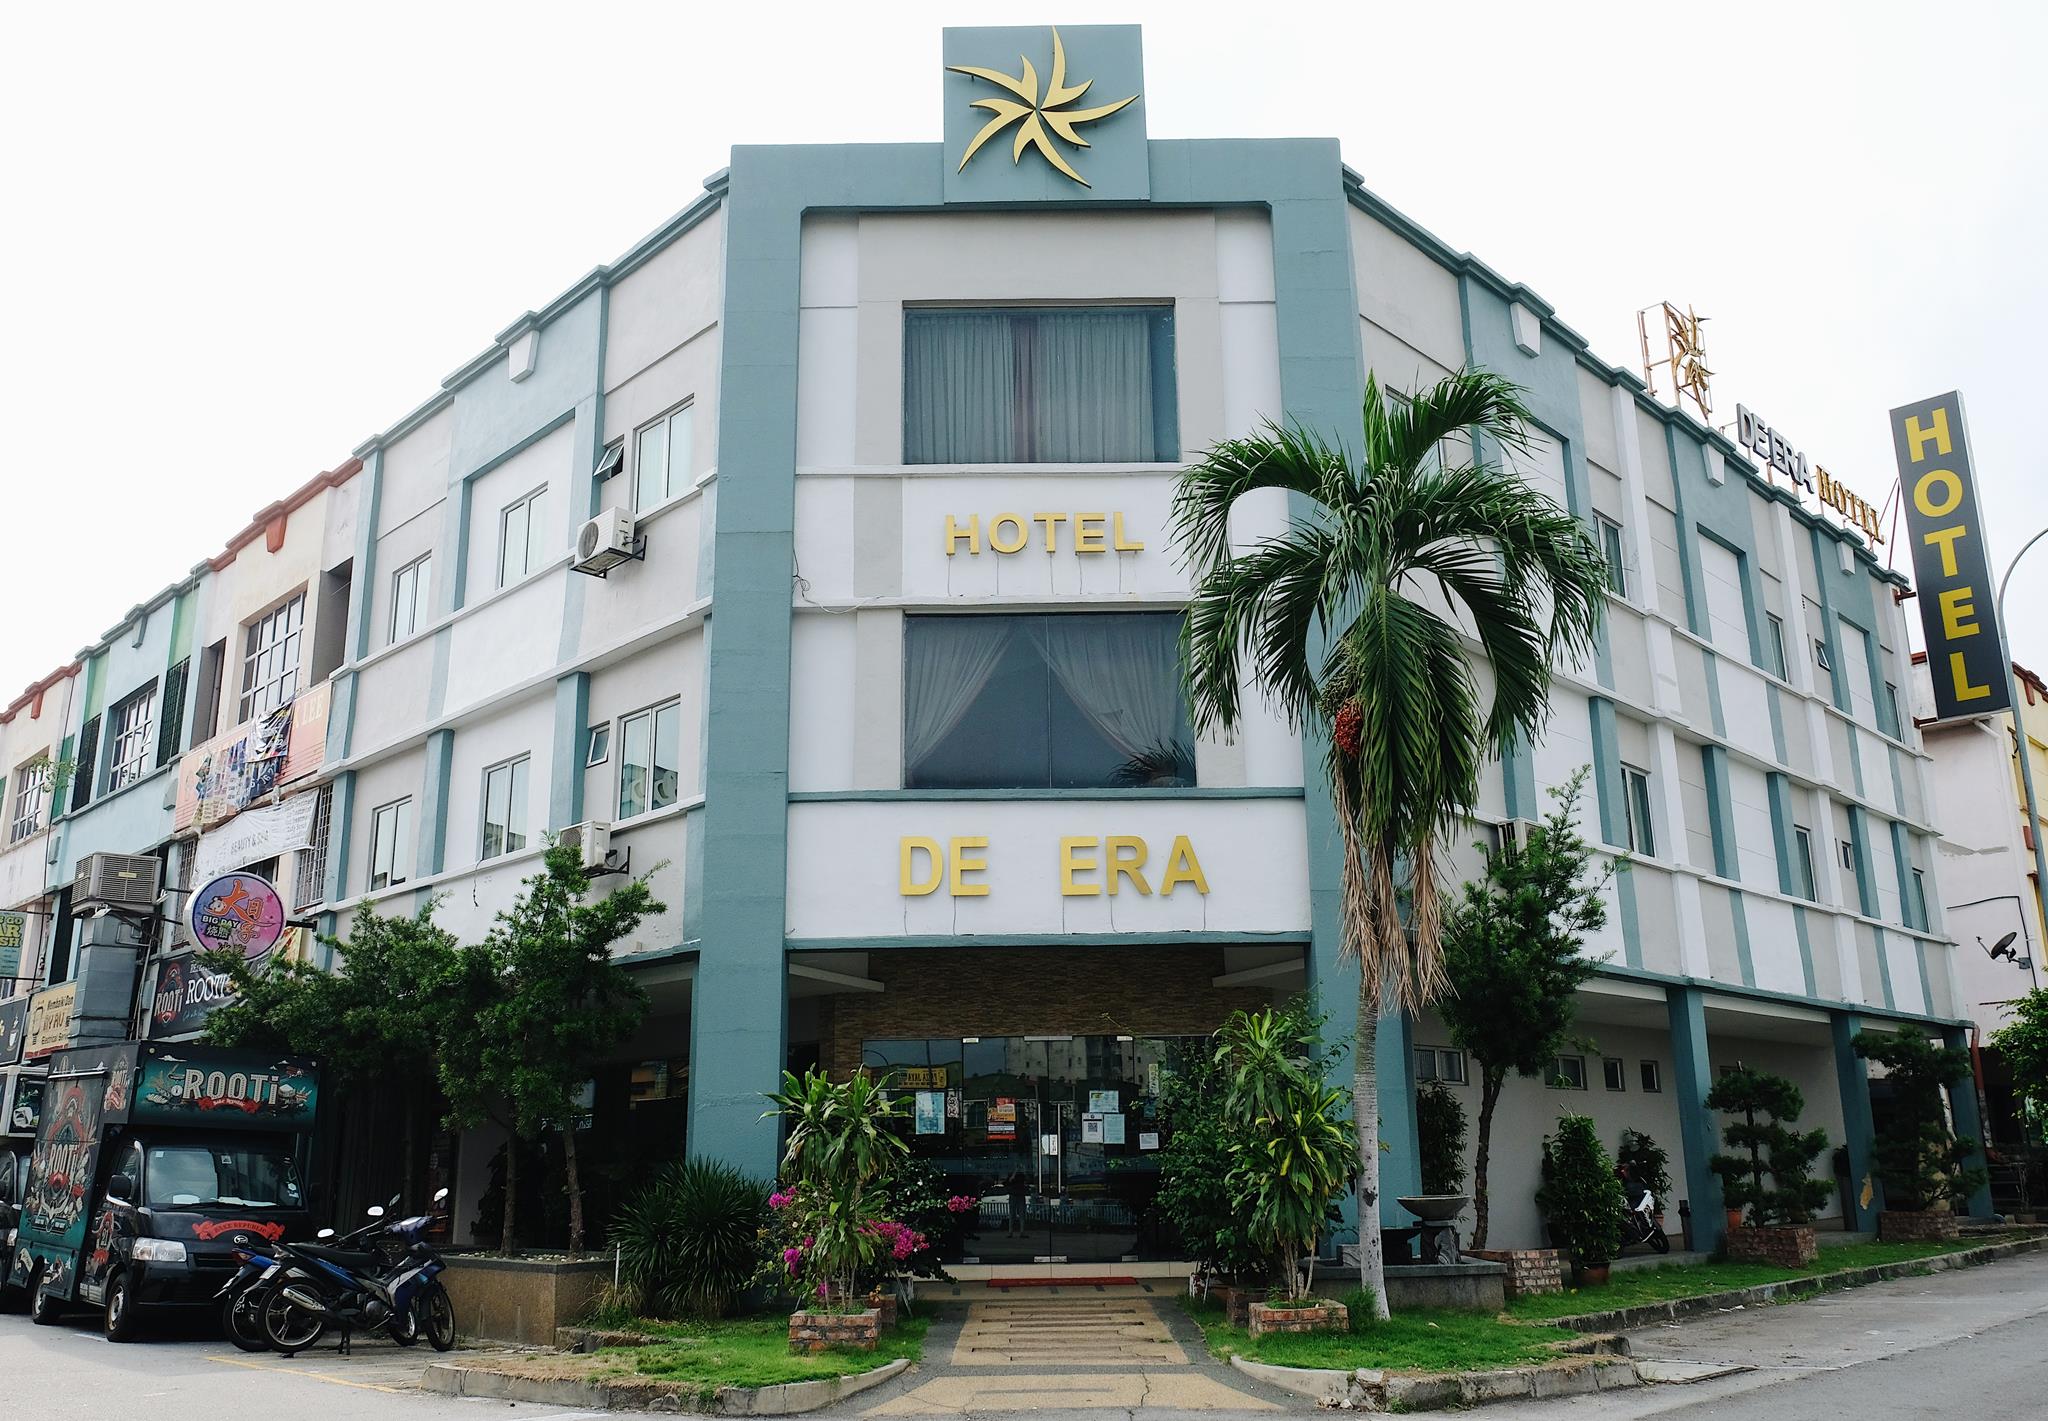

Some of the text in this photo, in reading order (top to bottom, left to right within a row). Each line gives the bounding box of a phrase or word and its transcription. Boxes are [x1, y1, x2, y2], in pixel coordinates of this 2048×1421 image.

[1736, 403, 1885, 546] DE ERA HOTEL
[945, 511, 1145, 556] HOTEL
[1904, 406, 1991, 702] HOTEL
[900, 835, 1210, 896] DE ERA
[202, 915, 239, 928] BIG DAY
